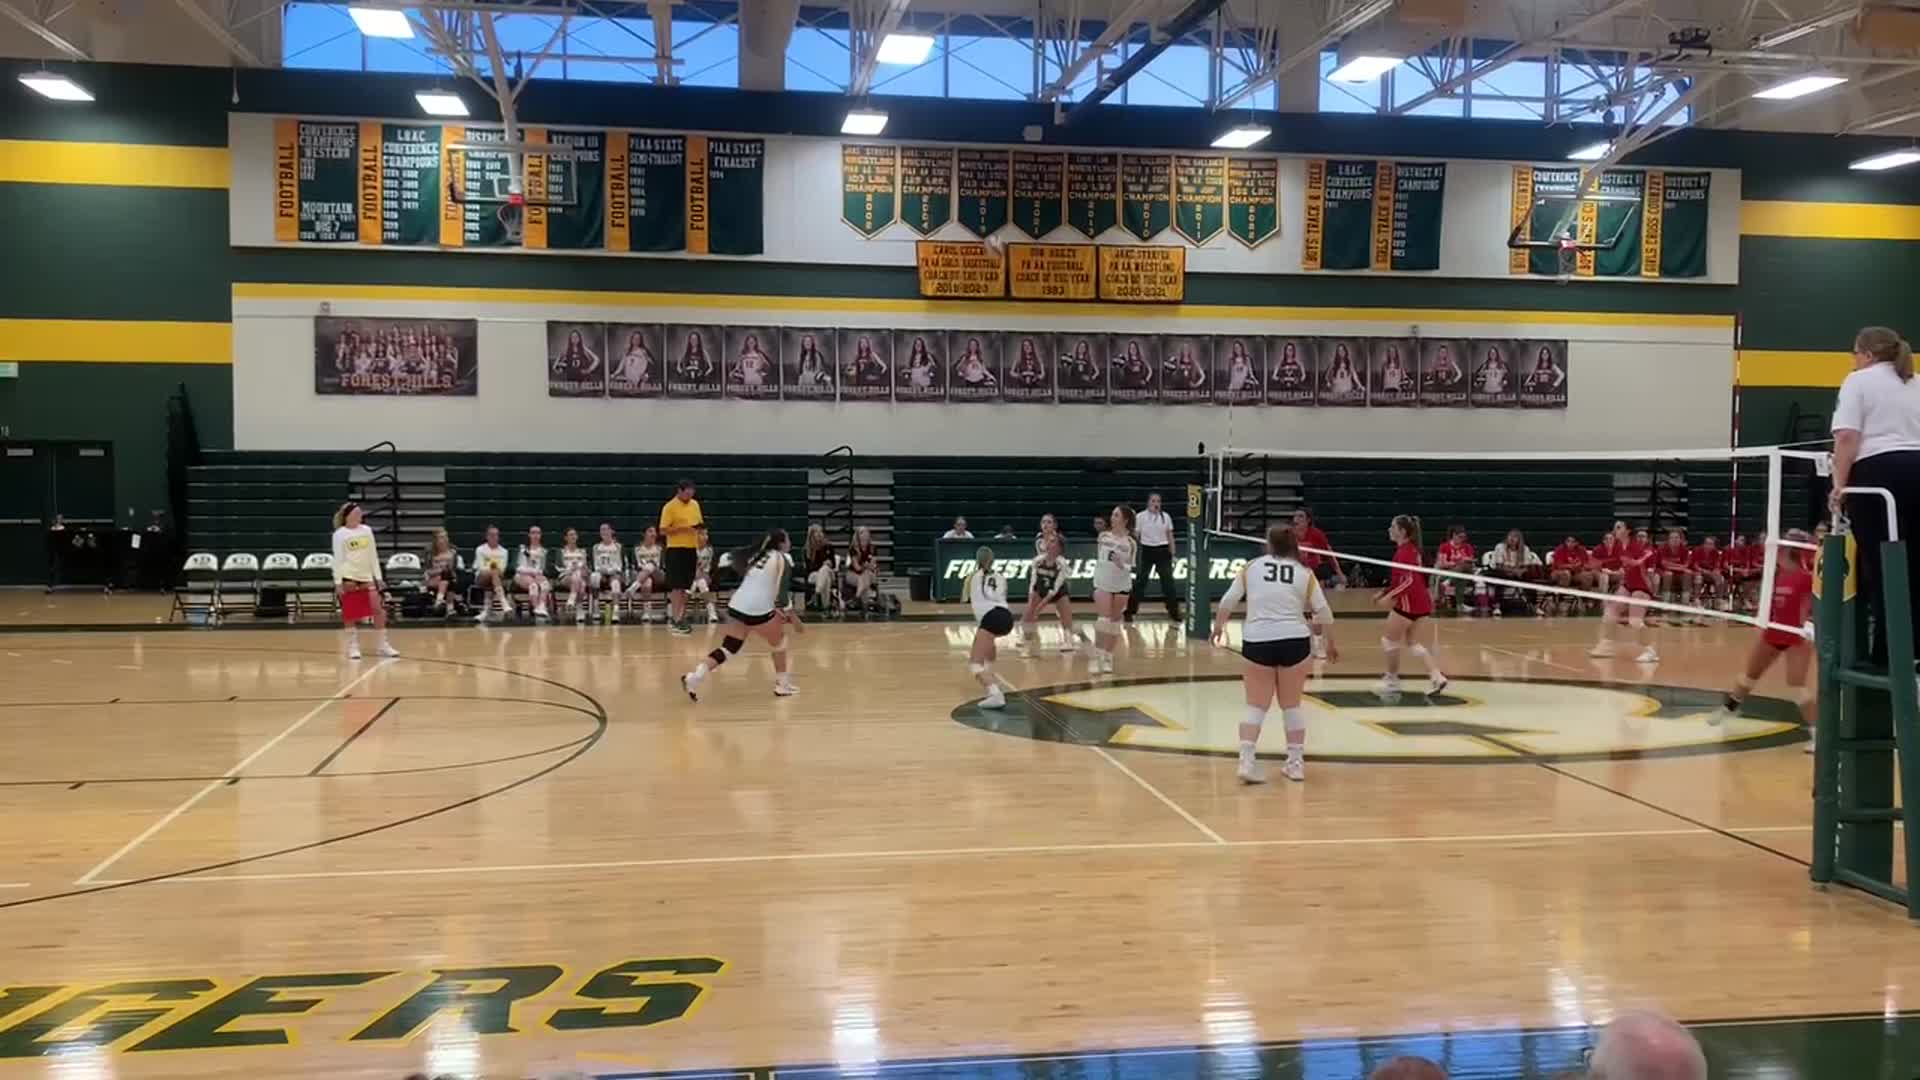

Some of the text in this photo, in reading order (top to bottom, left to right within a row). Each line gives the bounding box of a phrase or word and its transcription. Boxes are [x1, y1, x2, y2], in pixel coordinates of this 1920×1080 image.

[279, 143, 295, 219] FOOTBALL
[363, 145, 378, 220] FOOTBALL
[611, 154, 625, 229] FOOTBALL
[690, 158, 705, 231] FOOTBALL
[1069, 192, 1116, 200] CHAMPION
[943, 559, 1034, 579] FOEST
[1263, 562, 1294, 584] 30
